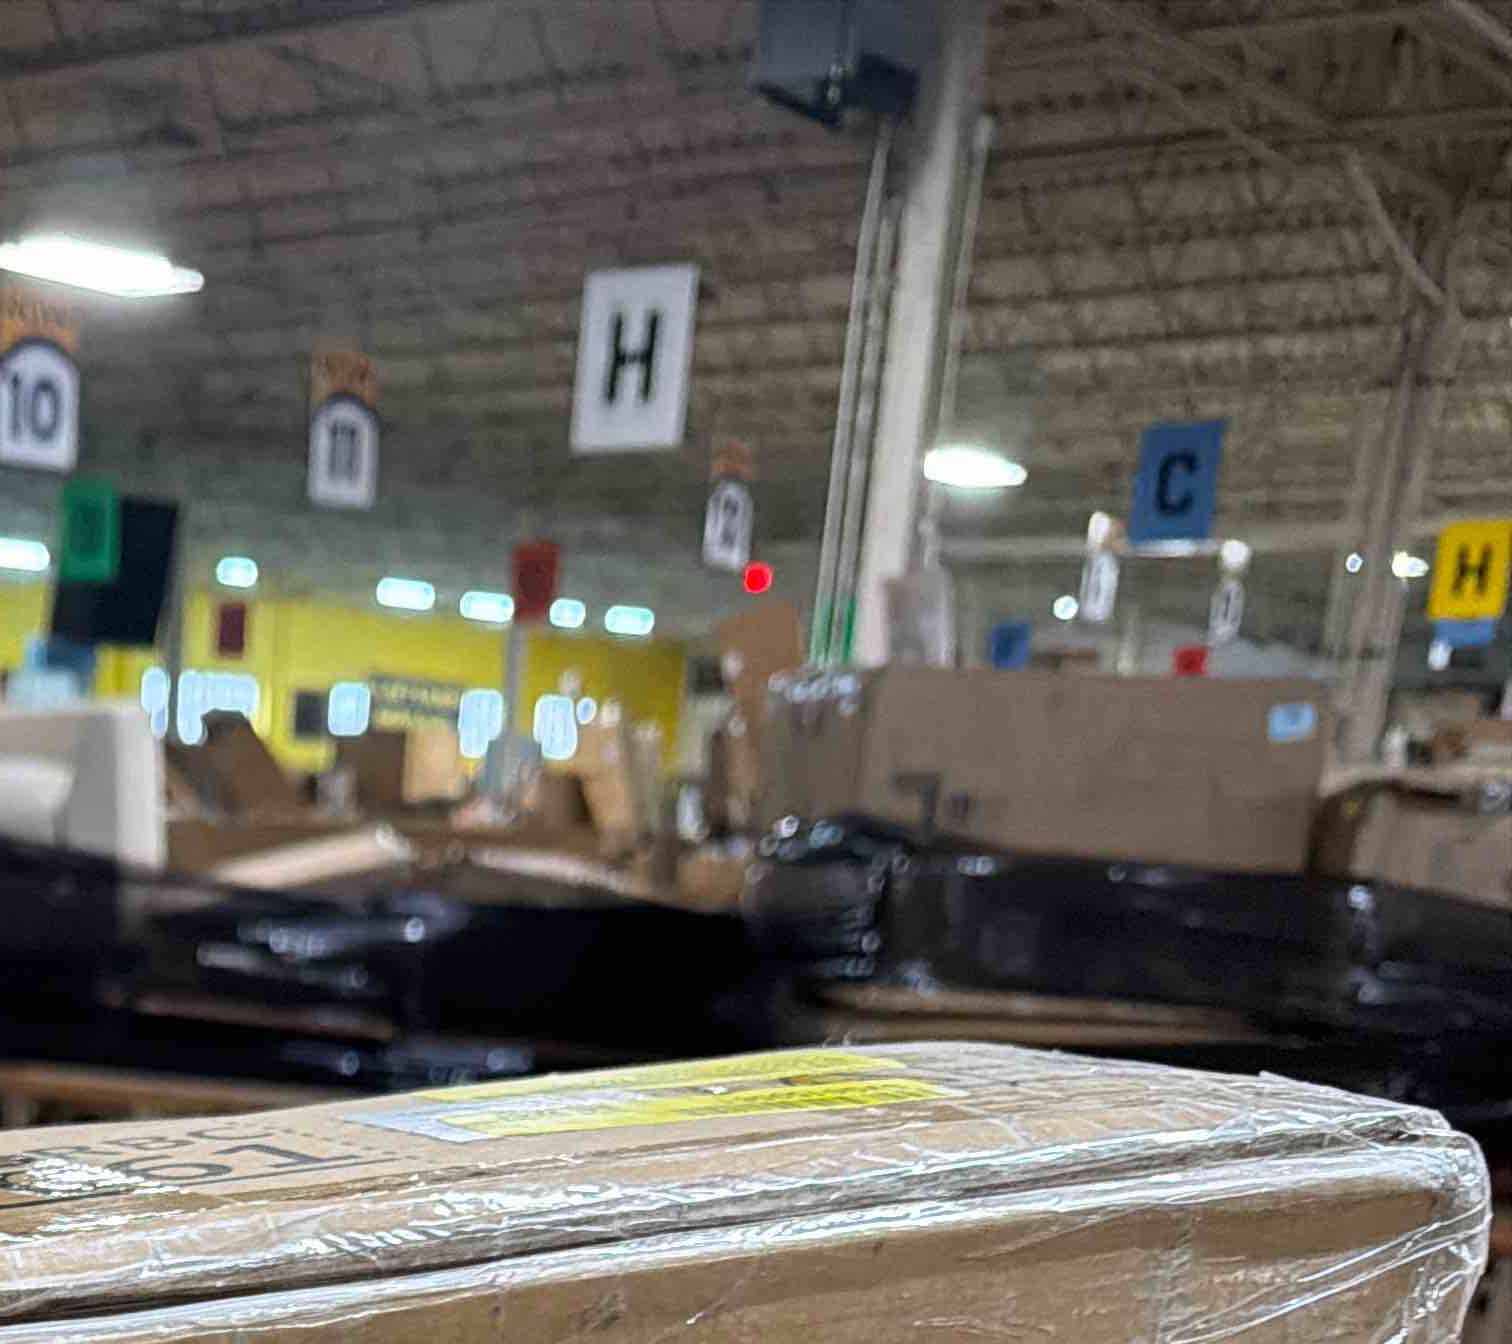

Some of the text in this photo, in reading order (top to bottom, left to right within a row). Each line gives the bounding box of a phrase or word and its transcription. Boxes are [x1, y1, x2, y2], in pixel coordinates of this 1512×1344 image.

[604, 309, 662, 405] H
[10, 368, 62, 443] 10
[1155, 451, 1198, 517] C
[1451, 542, 1493, 598] H
